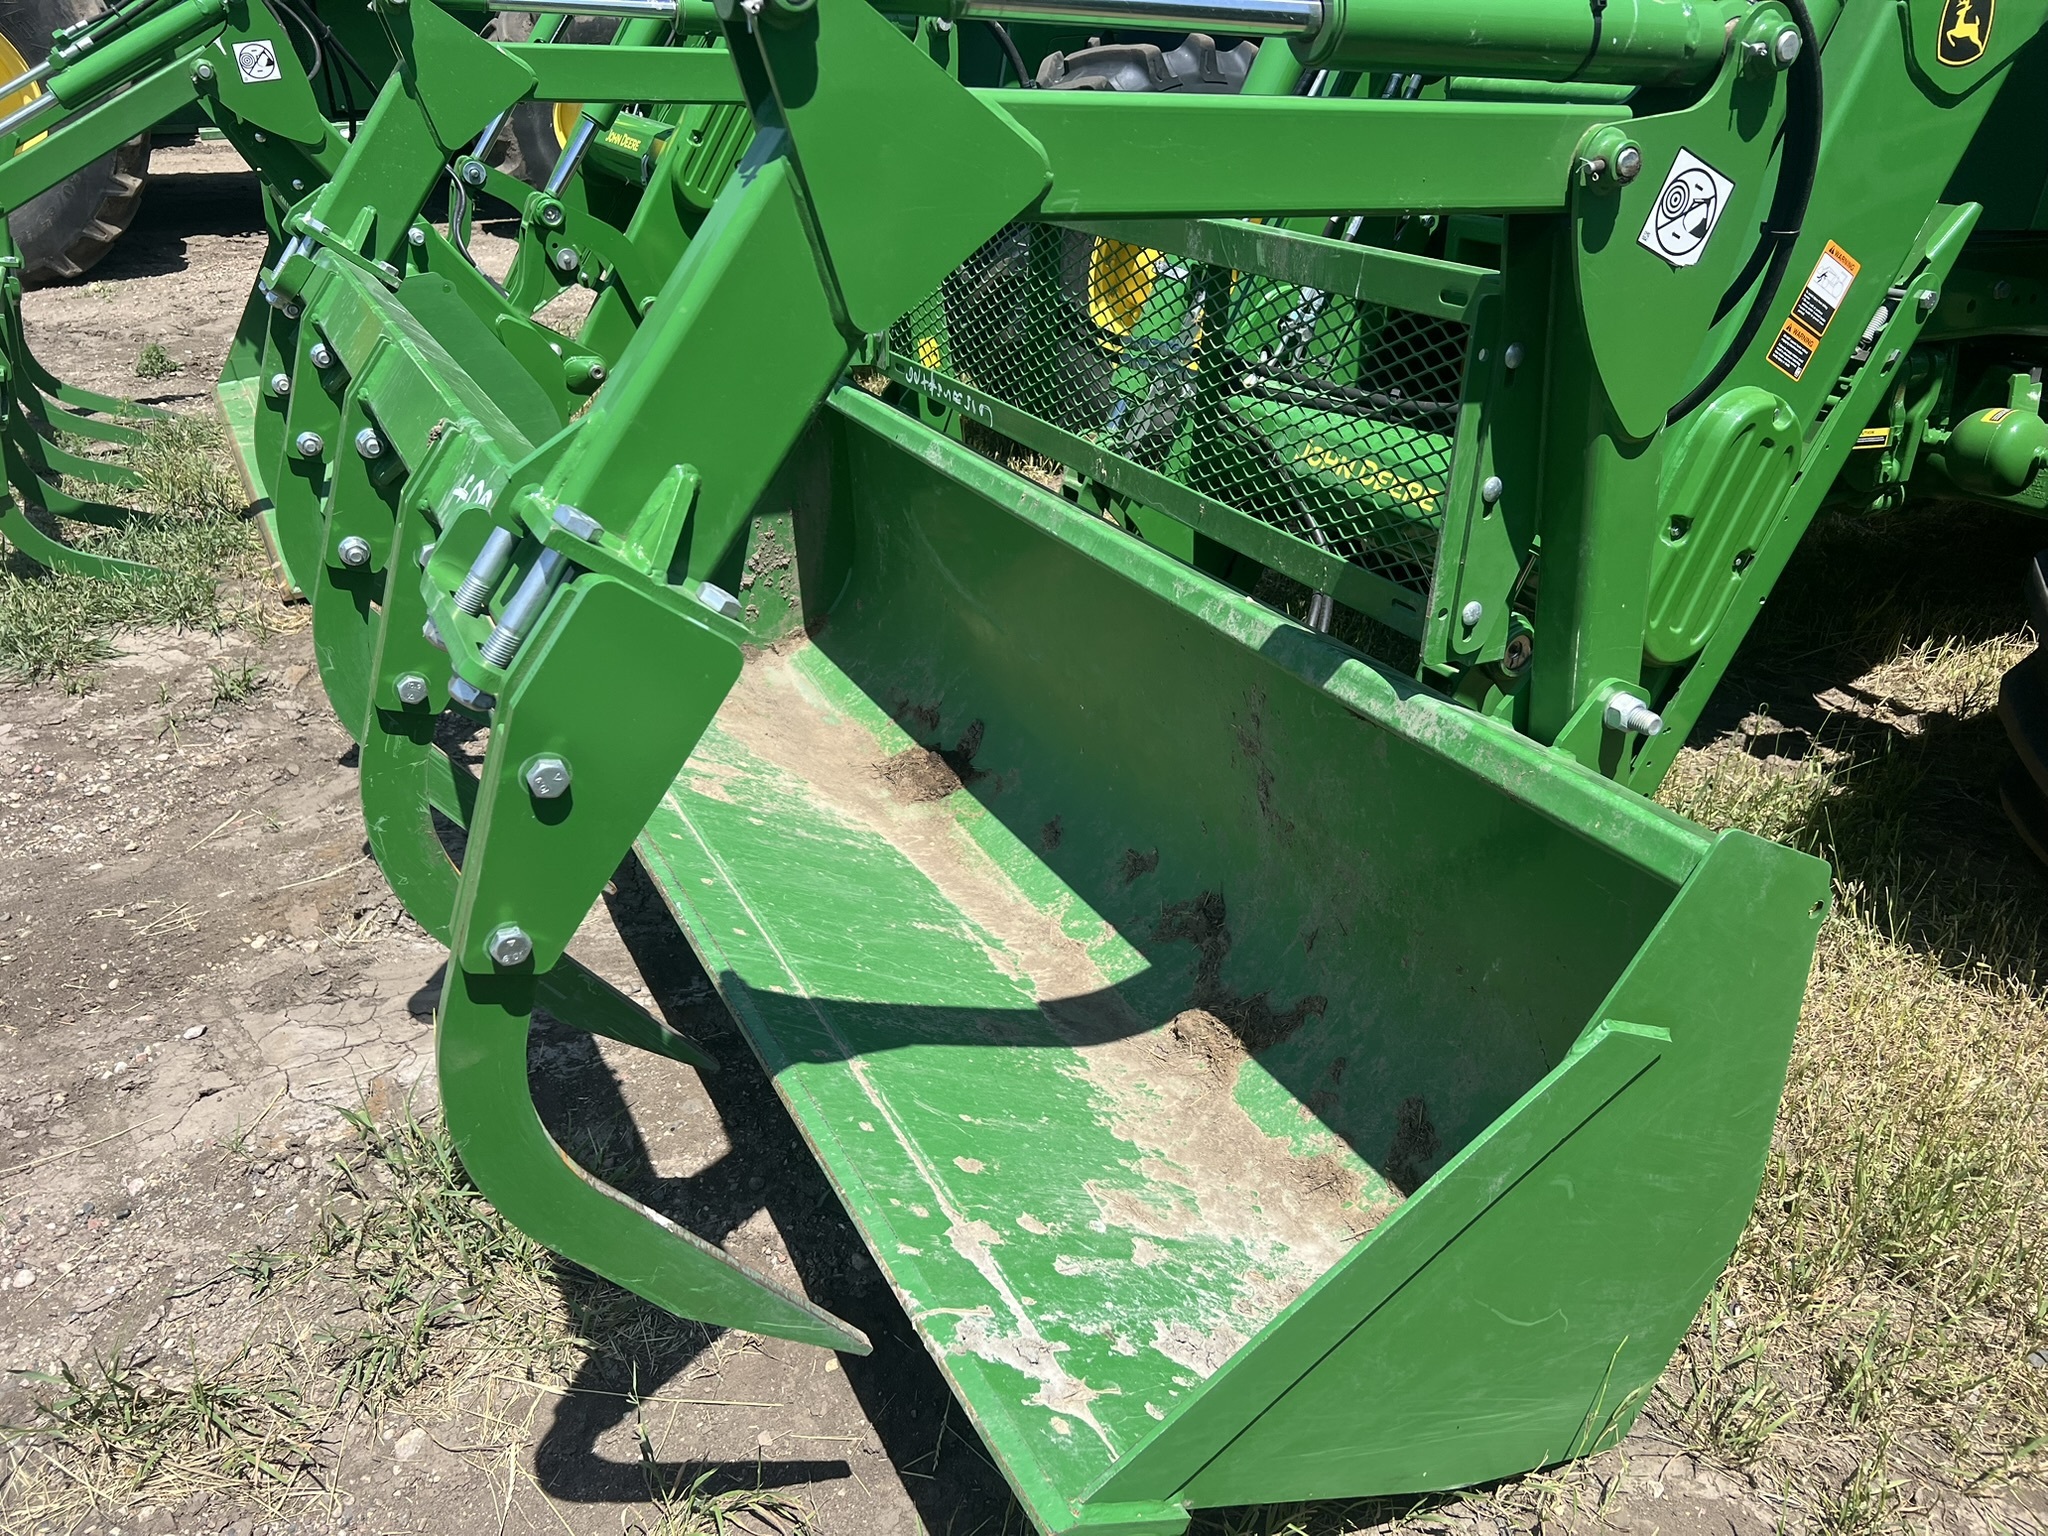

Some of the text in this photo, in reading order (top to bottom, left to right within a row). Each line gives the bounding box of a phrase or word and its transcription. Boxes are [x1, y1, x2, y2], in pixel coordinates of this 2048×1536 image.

[605, 129, 642, 152] JOHN DEERE
[1834, 250, 1856, 272] WARNING
[1793, 328, 1815, 348] WARNING
[1294, 439, 1441, 512] JOHN DEERE
